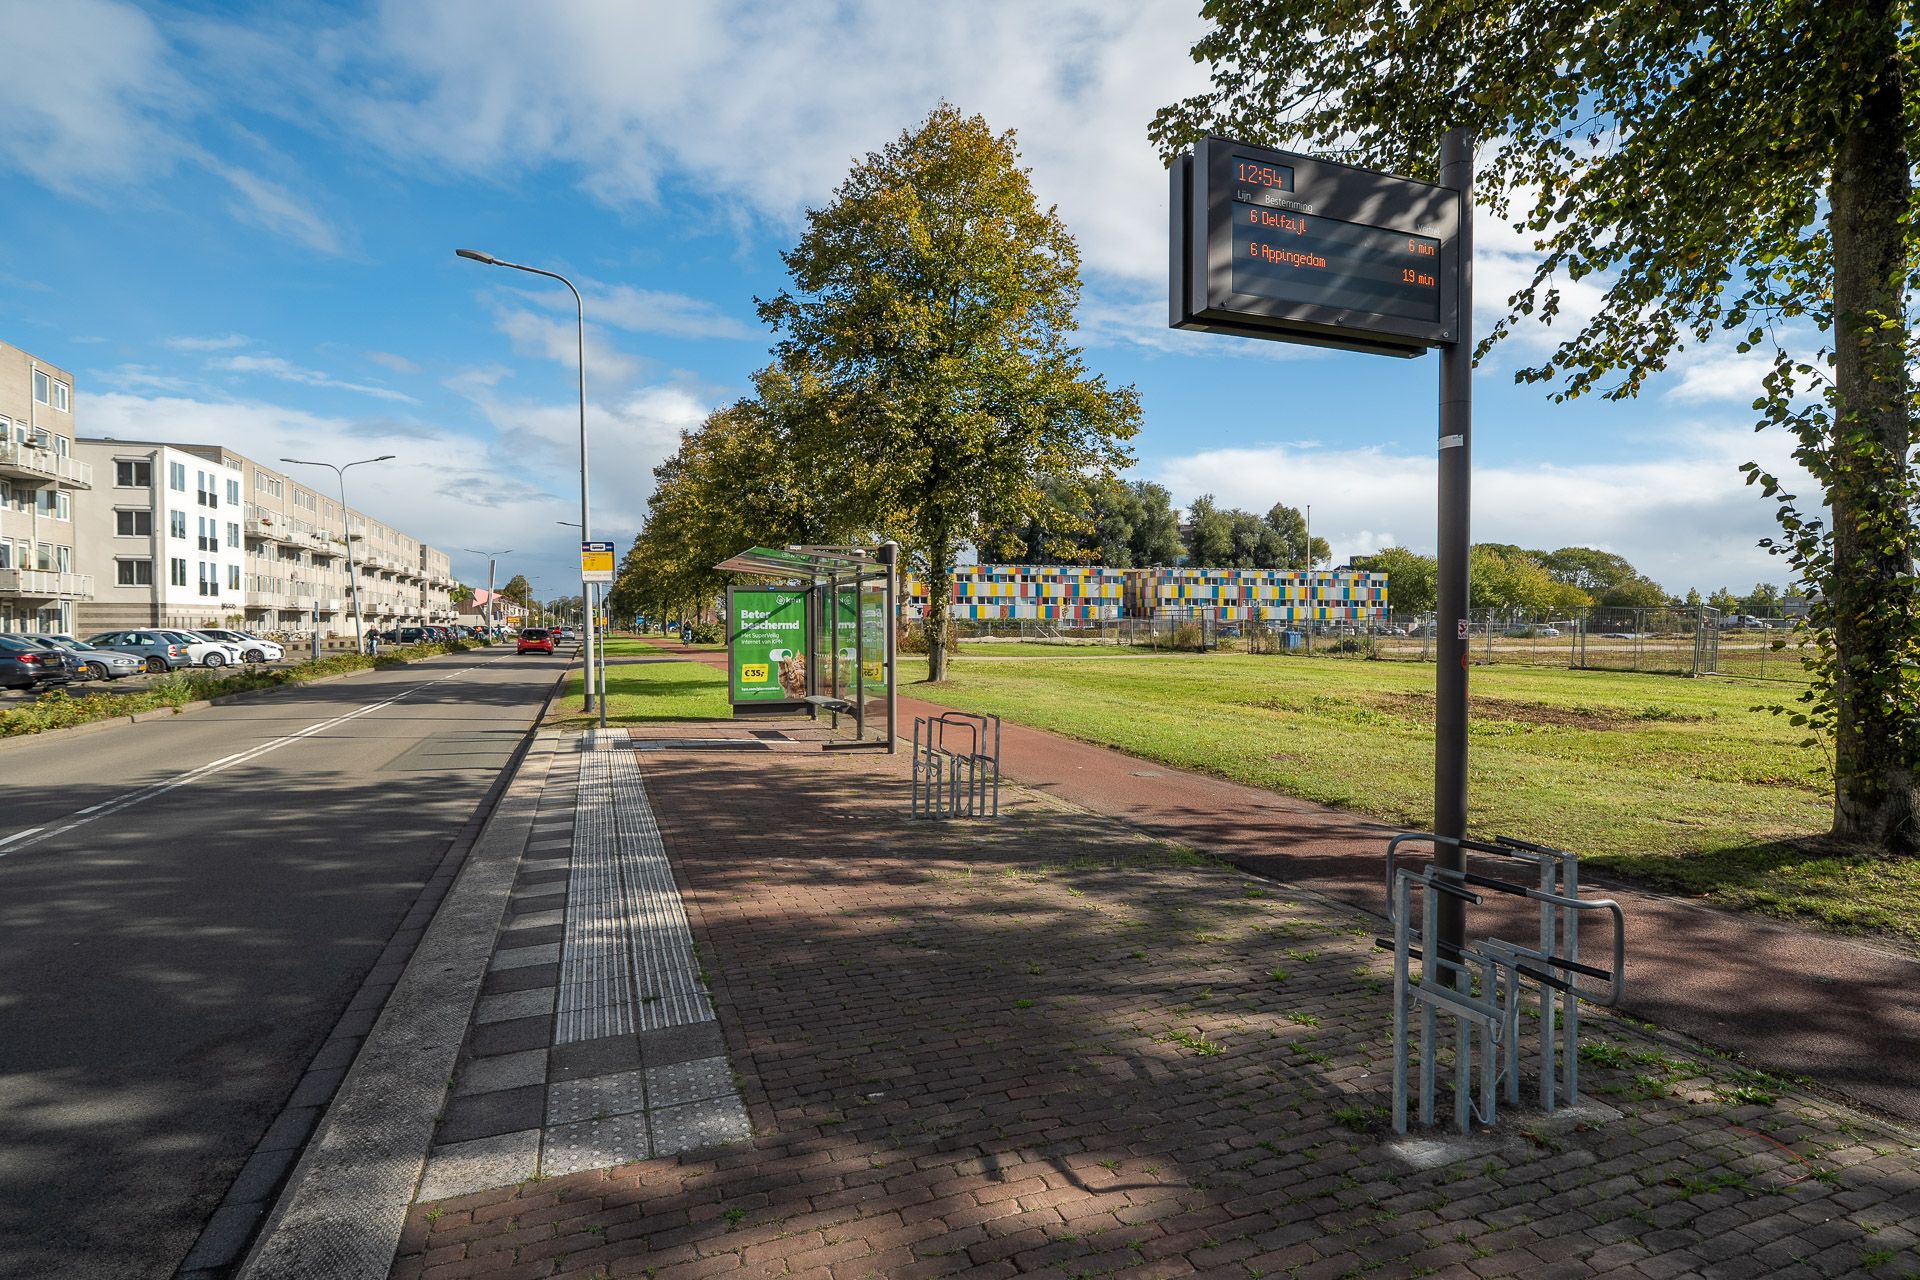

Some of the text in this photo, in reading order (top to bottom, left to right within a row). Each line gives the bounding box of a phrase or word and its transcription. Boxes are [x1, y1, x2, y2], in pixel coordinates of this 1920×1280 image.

[1239, 163, 1282, 188] 12:54
[1237, 190, 1441, 236] Lijn Bestemming Vertrek
[1250, 210, 1435, 257] 6 Delfzijl 6 min
[1250, 242, 1435, 287] 6 Appingedam 19 min
[741, 610, 771, 619] Beter
[741, 620, 799, 630] beschermd
